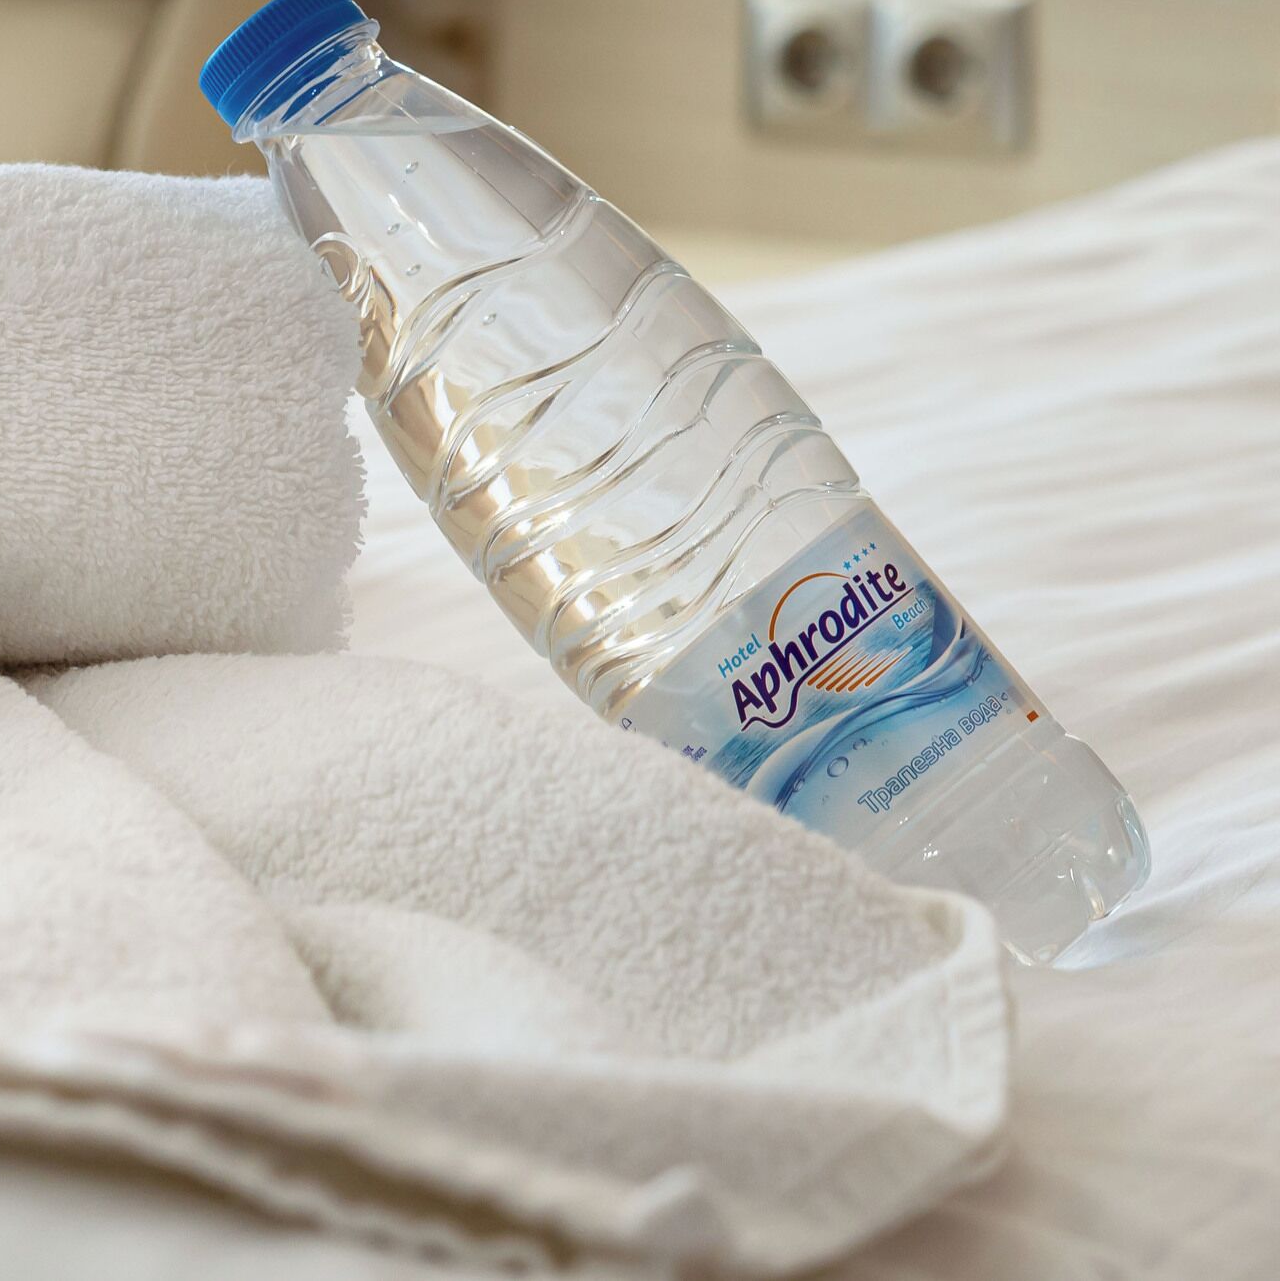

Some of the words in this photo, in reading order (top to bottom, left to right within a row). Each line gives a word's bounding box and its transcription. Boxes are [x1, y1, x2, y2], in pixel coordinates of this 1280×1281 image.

[731, 563, 906, 724] Aphrodite
[892, 596, 929, 631] Beach
[719, 633, 763, 679] Hotel
[857, 728, 963, 814] Трапезна
[958, 695, 1003, 736] вода
